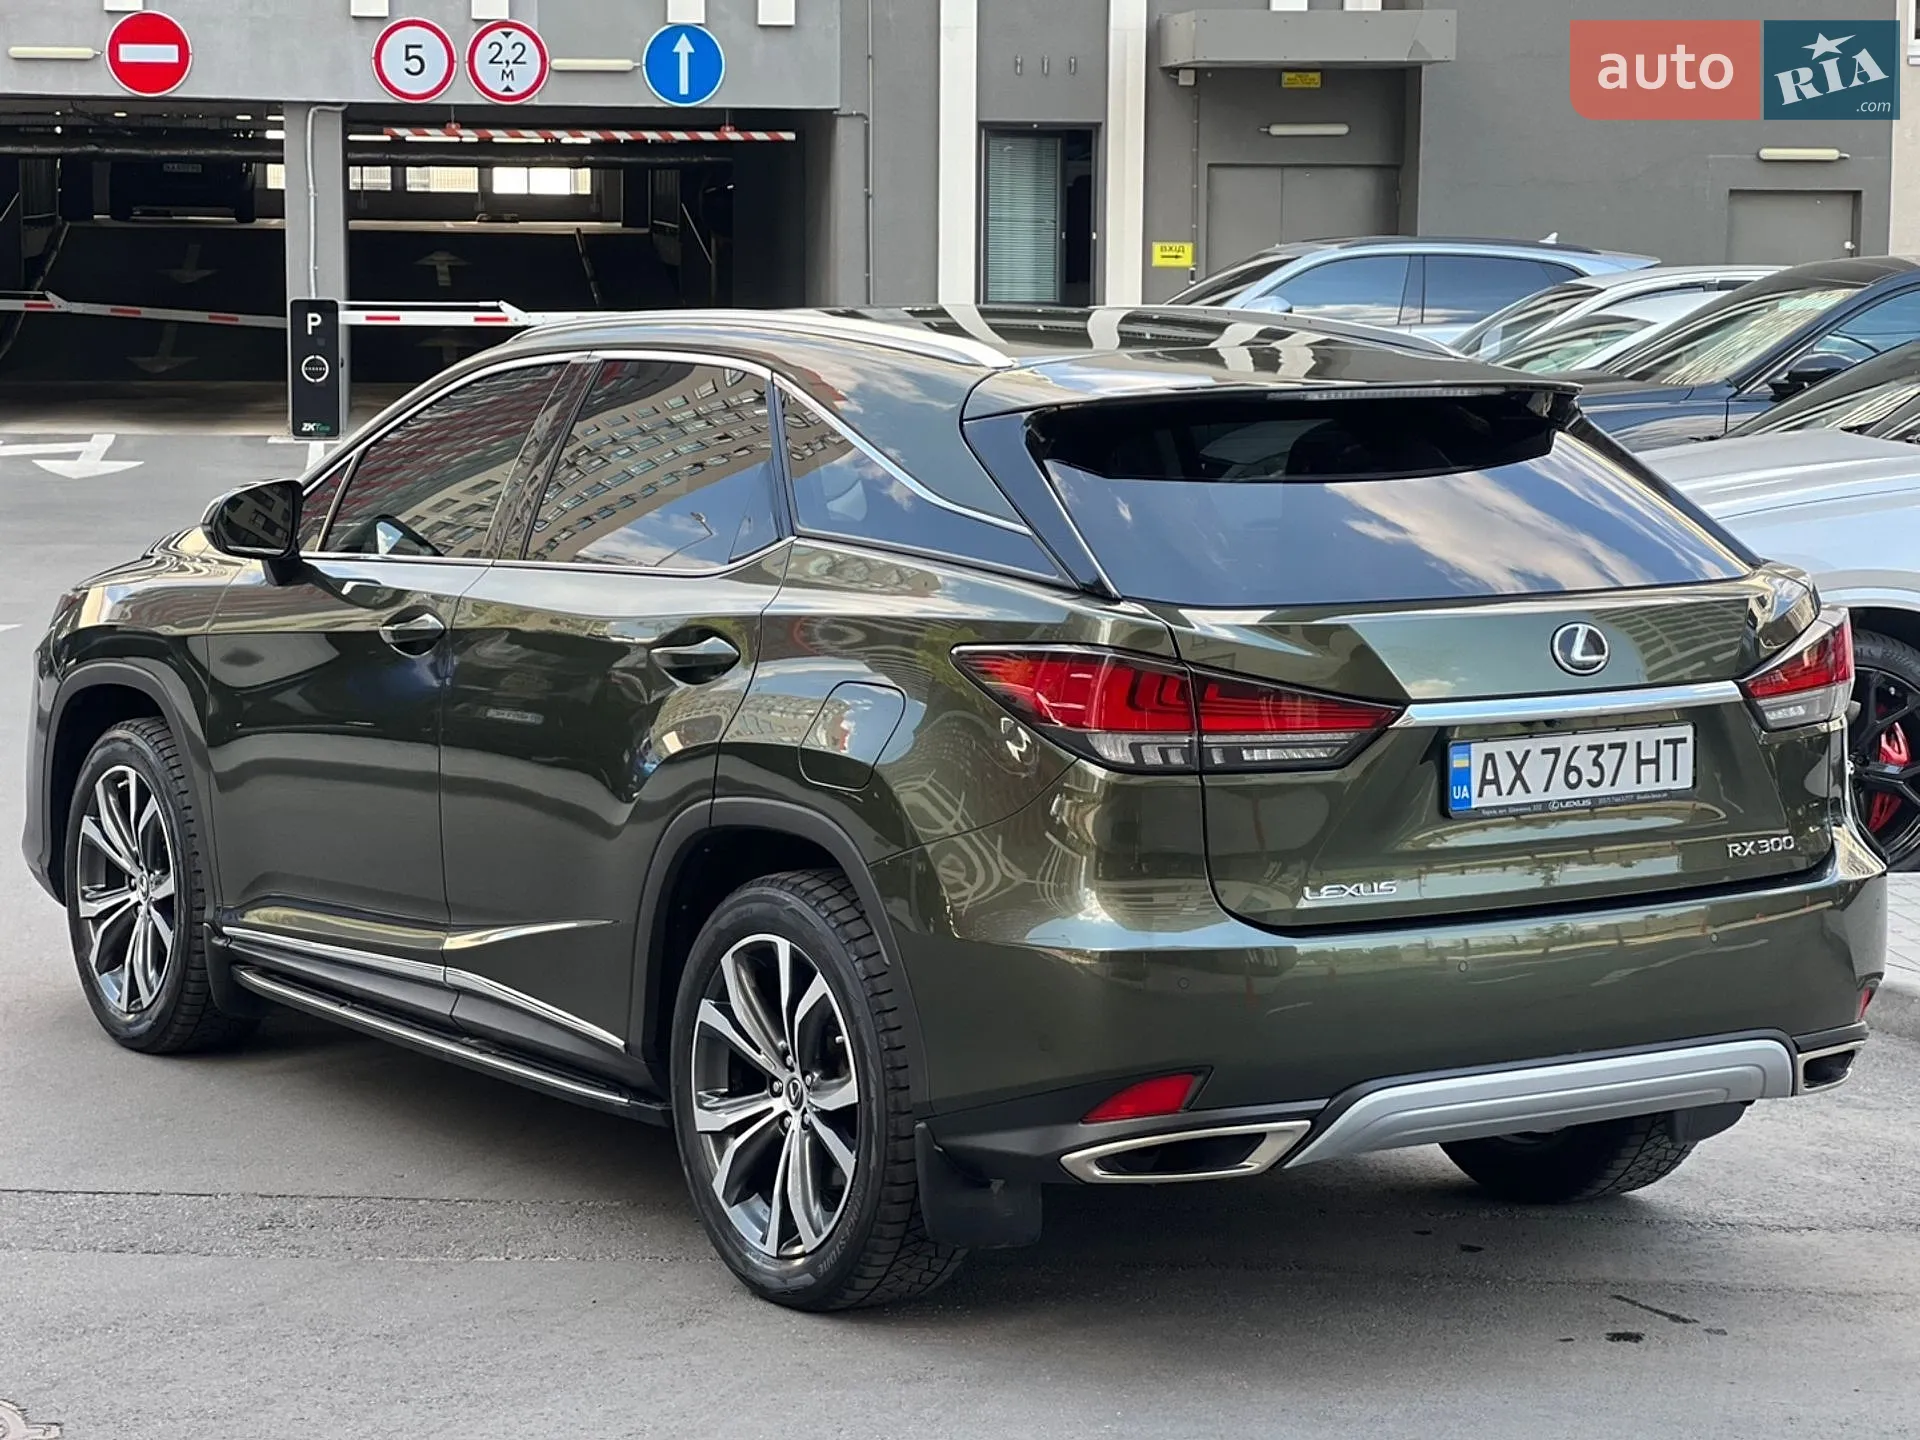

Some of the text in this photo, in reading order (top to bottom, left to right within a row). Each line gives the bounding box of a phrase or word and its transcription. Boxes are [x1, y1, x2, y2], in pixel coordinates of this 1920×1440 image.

[404, 44, 425, 76] 5
[488, 41, 526, 67] 2,2
[307, 313, 322, 335] P
[1478, 737, 1688, 798] AX 7637 HT
[1453, 787, 1470, 799] UA
[1559, 799, 1592, 809] LEXUS
[1727, 836, 1795, 858] RX 300
[1303, 881, 1397, 900] LEXUS
